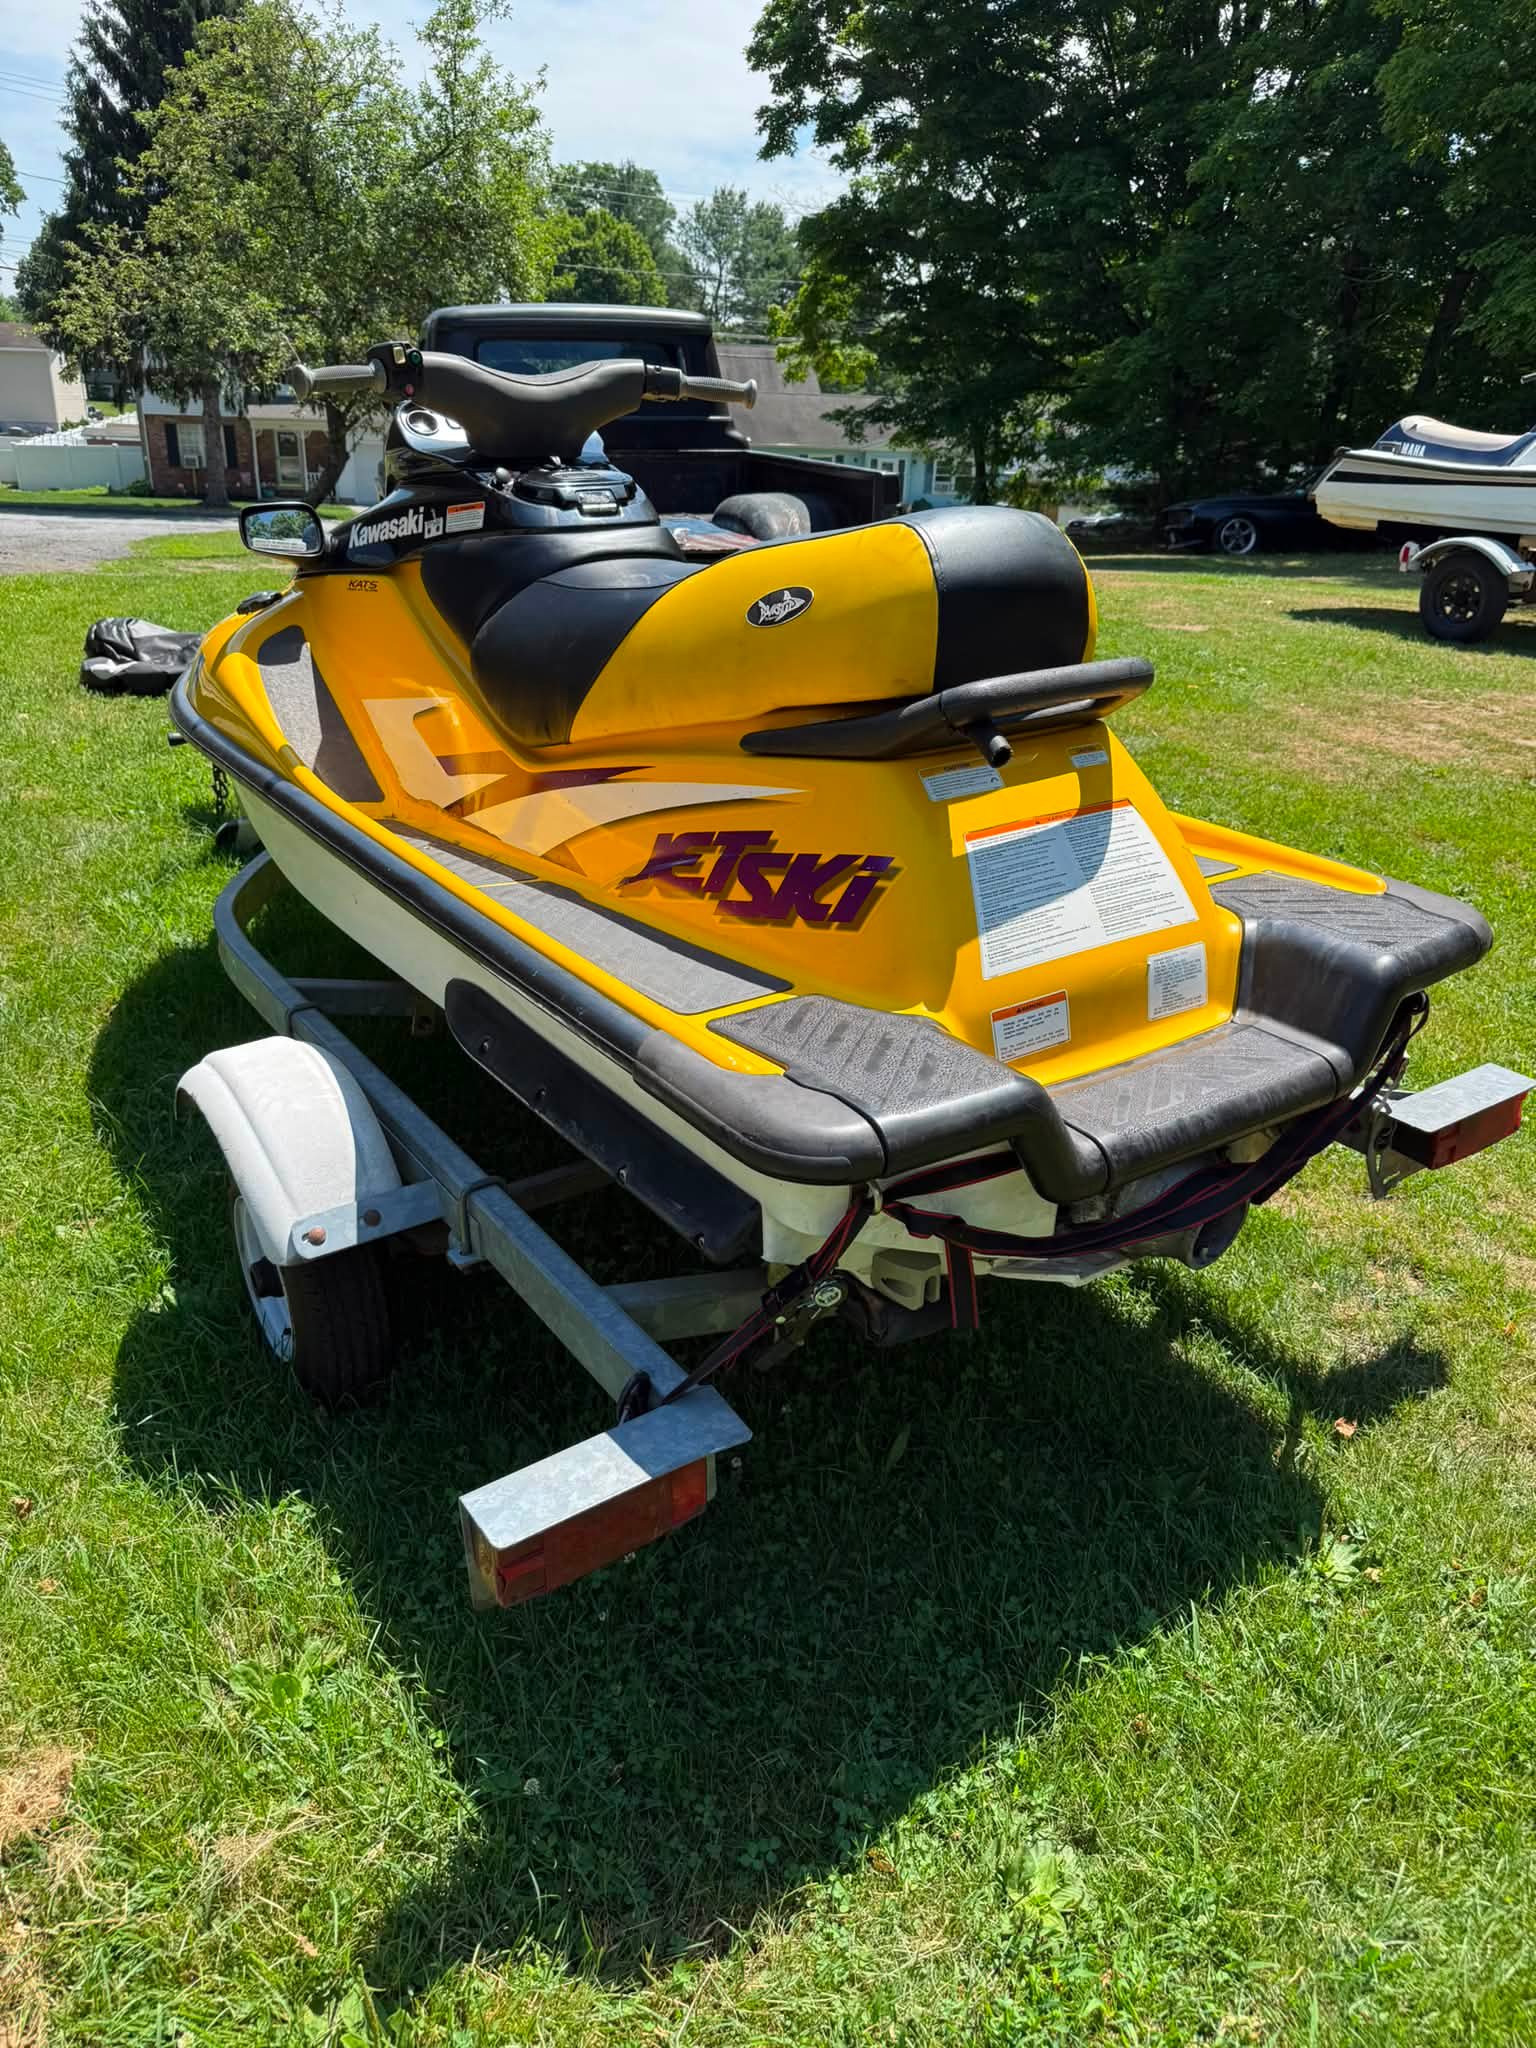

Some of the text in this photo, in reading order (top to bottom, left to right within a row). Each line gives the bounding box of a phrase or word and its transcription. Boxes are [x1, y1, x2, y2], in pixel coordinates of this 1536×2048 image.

[1393, 442, 1426, 457] MAHA
[349, 506, 425, 549] Kawasaki
[348, 579, 379, 589] KATS
[615, 830, 774, 894] JET
